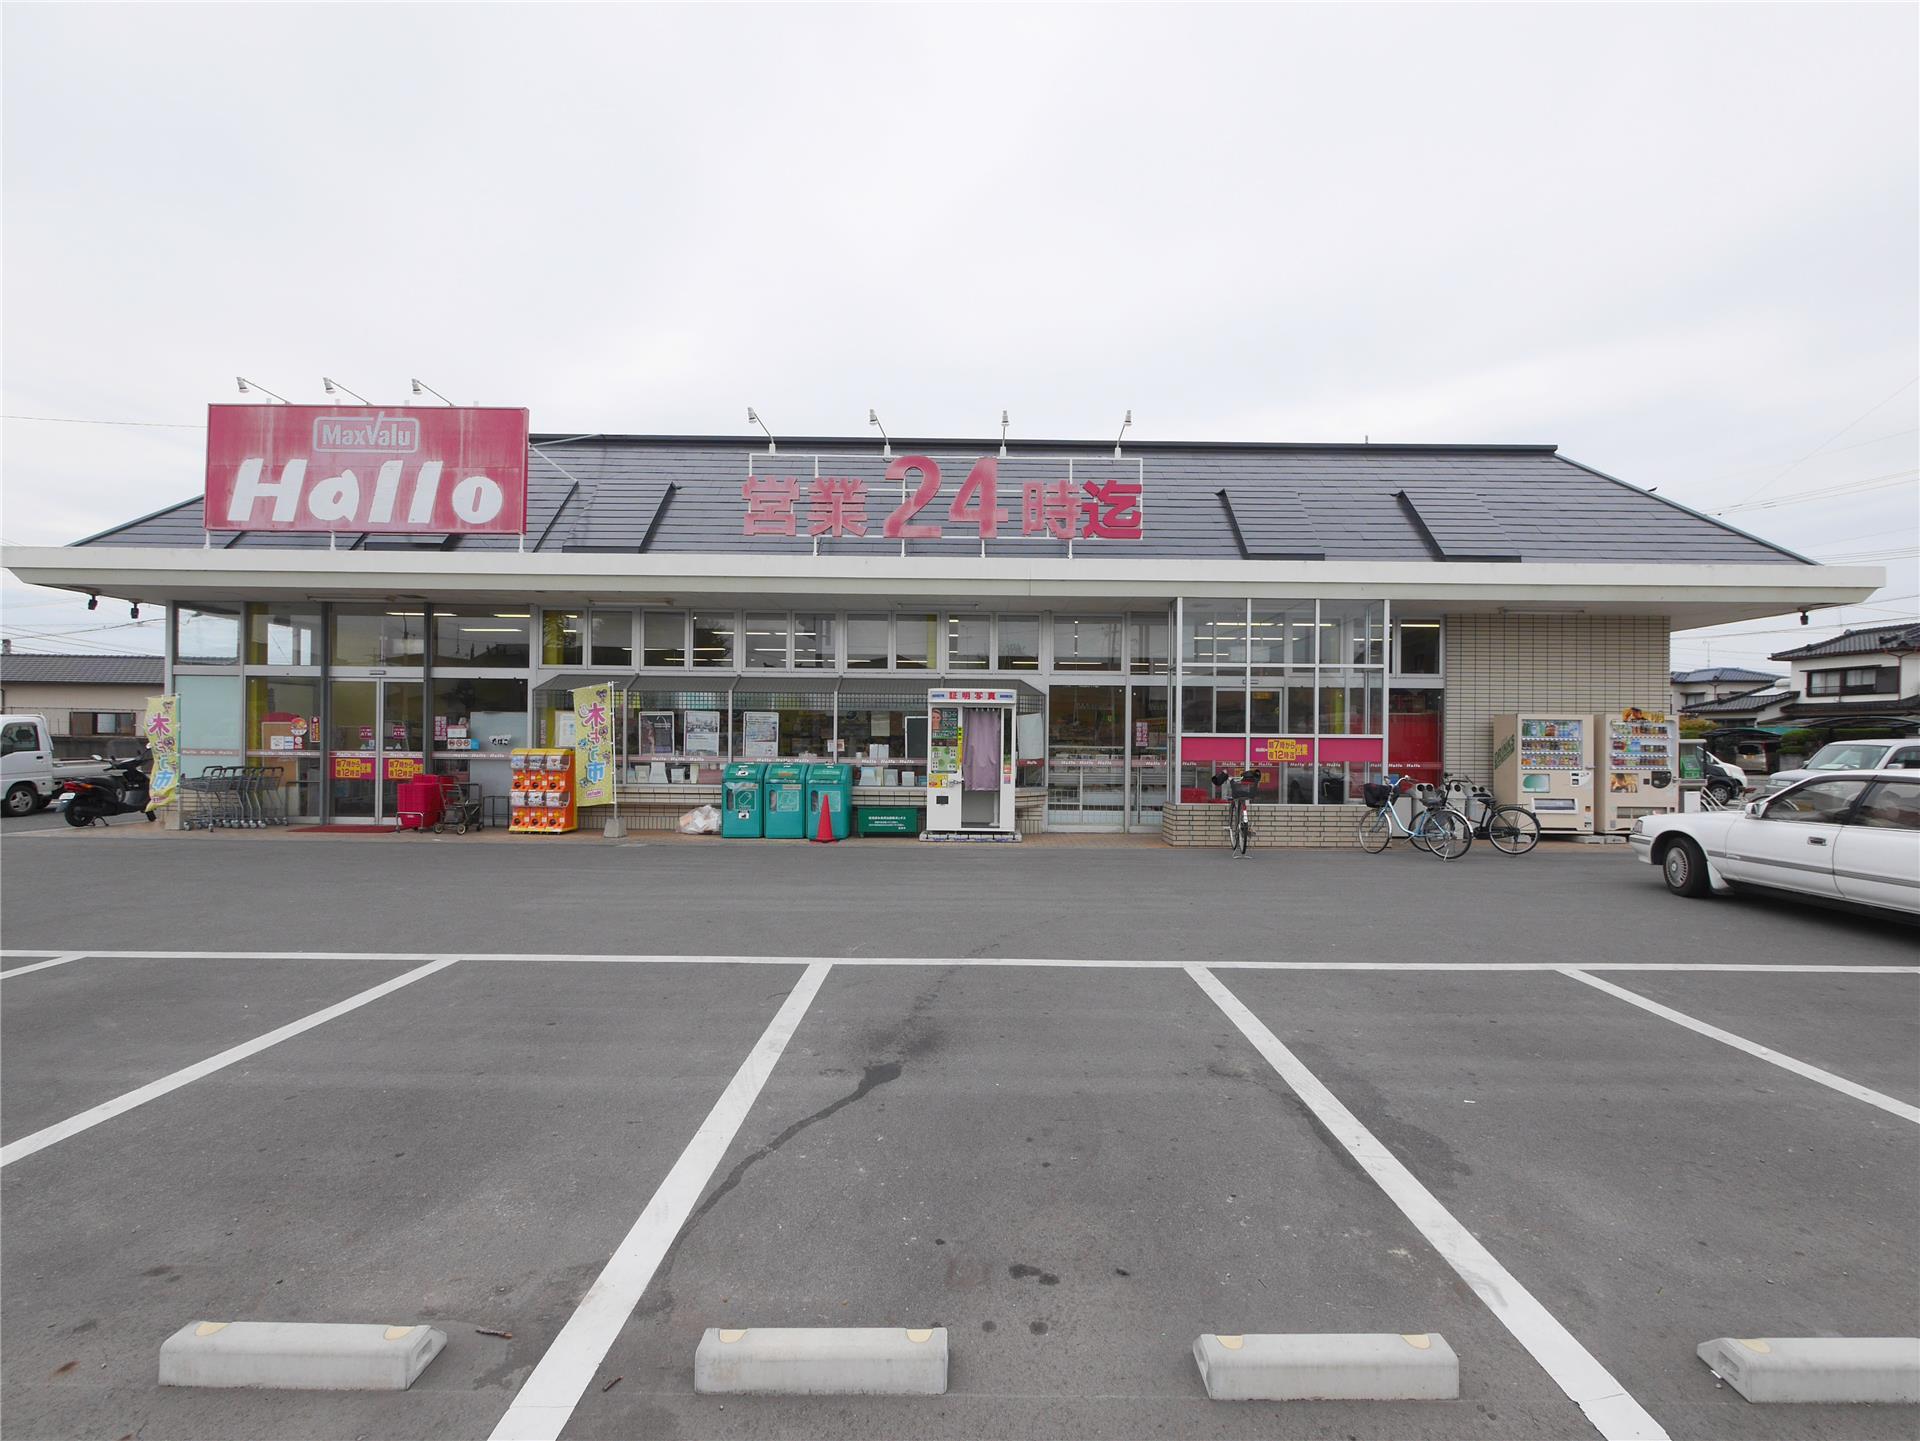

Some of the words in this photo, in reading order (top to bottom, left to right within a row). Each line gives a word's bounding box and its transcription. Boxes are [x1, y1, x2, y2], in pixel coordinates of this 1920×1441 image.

[322, 412, 411, 446] MaxValu
[227, 457, 503, 524] Hallo
[741, 455, 1143, 540] 営業24時迄
